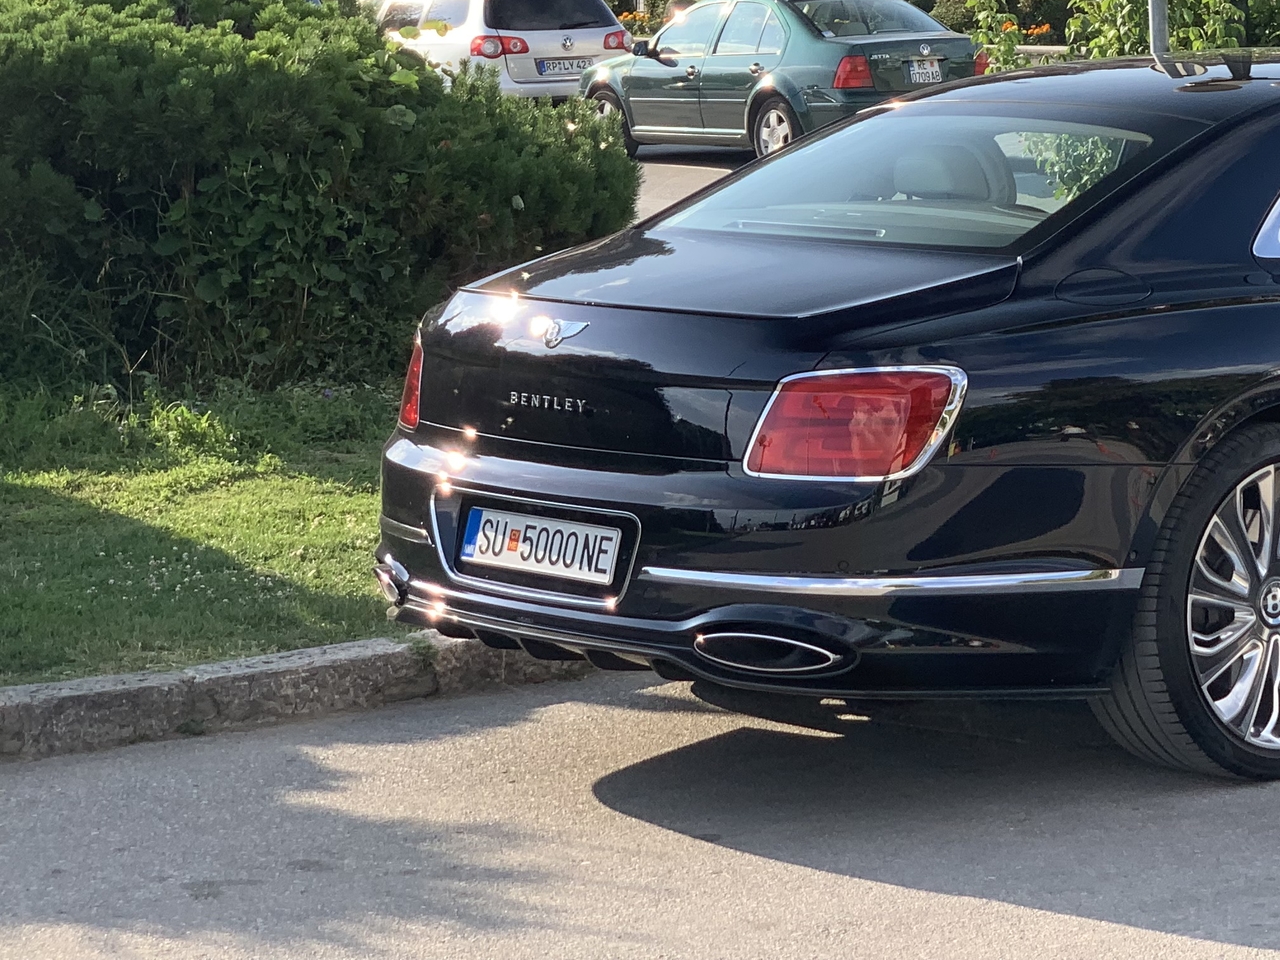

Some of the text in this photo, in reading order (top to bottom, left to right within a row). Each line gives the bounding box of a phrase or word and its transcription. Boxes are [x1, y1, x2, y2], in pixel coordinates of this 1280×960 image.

[546, 61, 558, 71] RP
[563, 61, 575, 71] LY
[917, 60, 927, 70] RE
[510, 391, 587, 412] BENTLEY
[478, 519, 508, 557] SU
